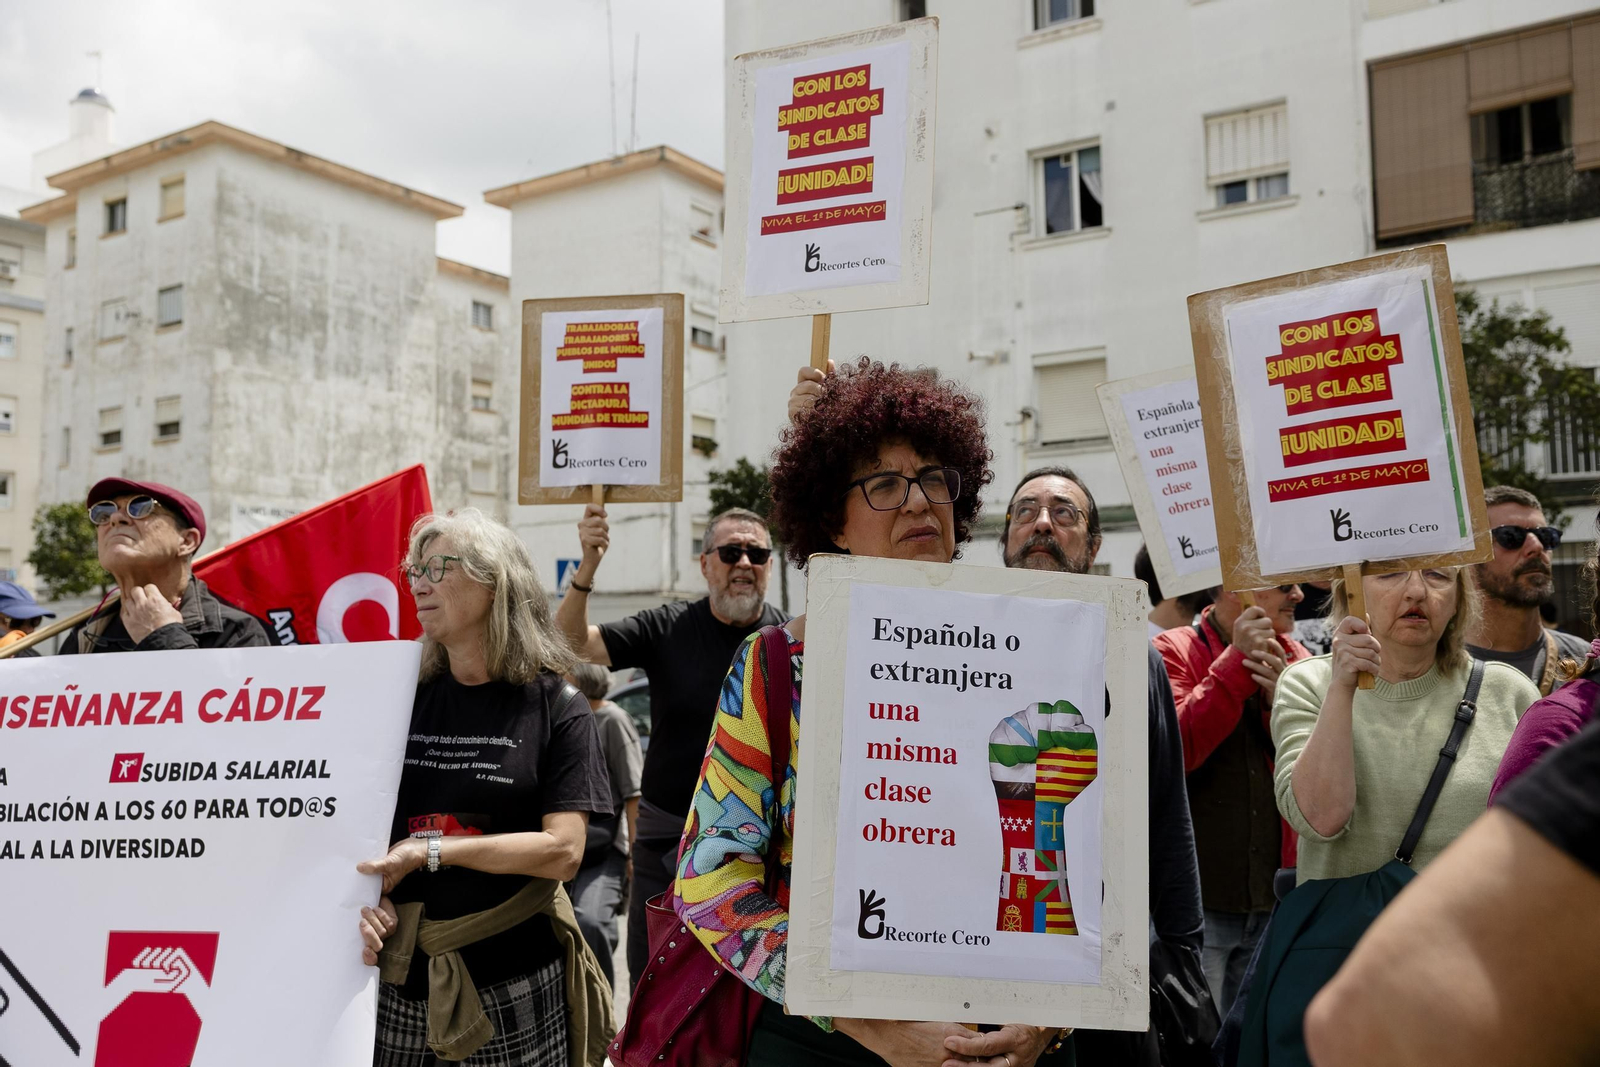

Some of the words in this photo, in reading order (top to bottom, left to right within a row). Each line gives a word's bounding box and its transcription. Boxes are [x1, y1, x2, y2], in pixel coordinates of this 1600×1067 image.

[793, 77, 831, 98] CON
[834, 70, 866, 90] LOS
[778, 94, 880, 127] SINDICATOS
[788, 131, 810, 151] DE
[813, 123, 867, 146] CLASE
[778, 163, 873, 195] ¡UNIDAD!
[761, 215, 793, 229] ¡VIVA
[796, 213, 811, 224] EL
[825, 209, 841, 220] DE
[844, 203, 886, 219] MAYO!
[820, 260, 860, 272] Recortes
[862, 256, 886, 267] Cero
[564, 334, 630, 345] TRABAJADORES
[630, 333, 638, 342] Y
[1280, 323, 1328, 347] CON
[1332, 314, 1375, 335] LOS
[556, 347, 592, 357] PUEBLOS
[593, 346, 610, 355] DEL
[610, 346, 645, 354] MUNDO
[1266, 341, 1397, 380] SINDICATOS
[583, 360, 616, 369] UNIDOS
[571, 384, 612, 396] CONTRA
[614, 383, 628, 394] LA
[1284, 385, 1313, 406] DE
[1317, 373, 1387, 400] CLASE
[570, 398, 628, 410] DICTADURA
[1136, 400, 1194, 422] Española
[552, 414, 595, 425] MUNDIAL
[597, 413, 610, 423] DE
[612, 413, 648, 424] TRUMP
[1281, 417, 1405, 456] ¡UNIDAD!
[569, 457, 615, 469] Recortes
[618, 456, 647, 468] Cero
[1149, 445, 1174, 459] una
[1156, 459, 1198, 478] misma
[1268, 478, 1308, 495] ¡VIVA
[1312, 476, 1331, 488] EL
[1349, 470, 1371, 482] DE
[1374, 462, 1428, 479] MAYO!
[1162, 480, 1192, 497] clase
[1168, 497, 1211, 516] obrera
[1353, 526, 1406, 541] Recortes
[1408, 521, 1439, 534] Cero
[1194, 545, 1219, 558] Recort
[872, 617, 997, 652] Española
[1005, 634, 1020, 652] o
[870, 659, 1013, 693] extranjera
[0, 684, 184, 729] SEÑANZA
[198, 677, 326, 724] CÁDIZ
[868, 701, 920, 723] una
[457, 736, 488, 744] conocimiento
[866, 737, 958, 765] misma
[140, 762, 218, 783] SUBIDA
[224, 759, 332, 780] SALARIAL
[420, 760, 437, 768] ESTÁ
[487, 774, 514, 785] FEYNMAN
[864, 776, 932, 804] clase
[94, 801, 109, 821] A
[115, 800, 155, 820] LOS
[161, 799, 187, 820] 60
[194, 798, 250, 819] PARA
[256, 796, 337, 818] TOD@S
[410, 815, 437, 829] CGT
[862, 817, 956, 848] obrera
[0, 840, 25, 860] AL
[30, 840, 44, 859] A
[50, 839, 75, 859] LA
[80, 838, 205, 859] DIVERSIDAD
[884, 925, 948, 945] Recorte
[951, 928, 991, 947] Cero
